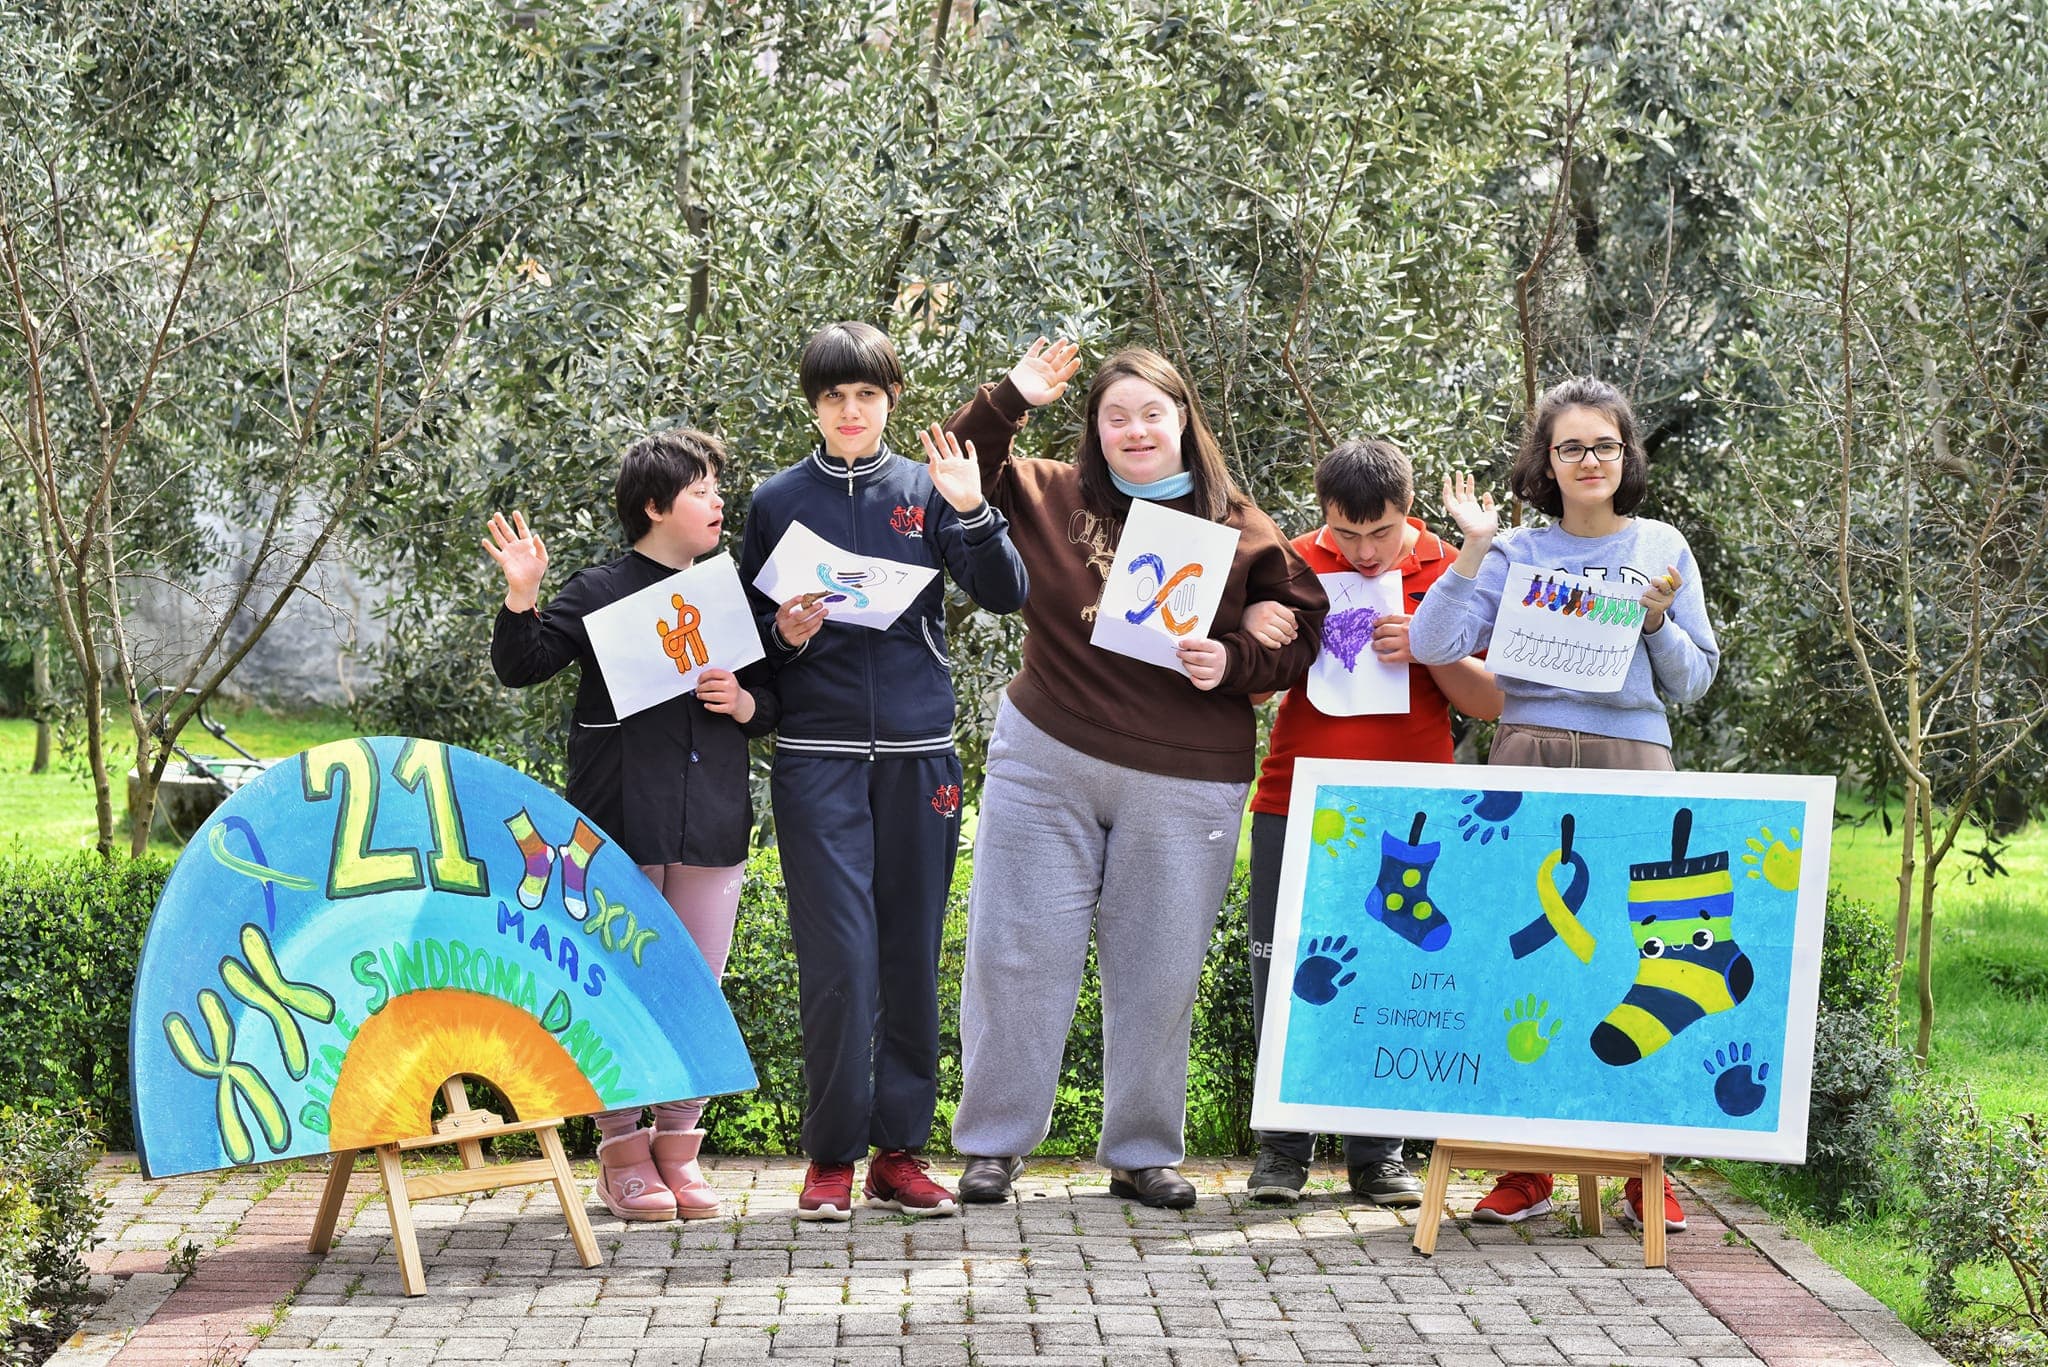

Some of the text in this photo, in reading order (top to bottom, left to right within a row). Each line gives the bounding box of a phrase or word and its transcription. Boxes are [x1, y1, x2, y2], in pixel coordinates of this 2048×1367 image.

[300, 737, 490, 900] 21
[497, 901, 606, 997] MARS
[299, 1044, 346, 1135] DITA
[350, 938, 539, 1019] SINDROMA
[1353, 1006, 1367, 1024] E
[1374, 1046, 1481, 1085] DOWN
